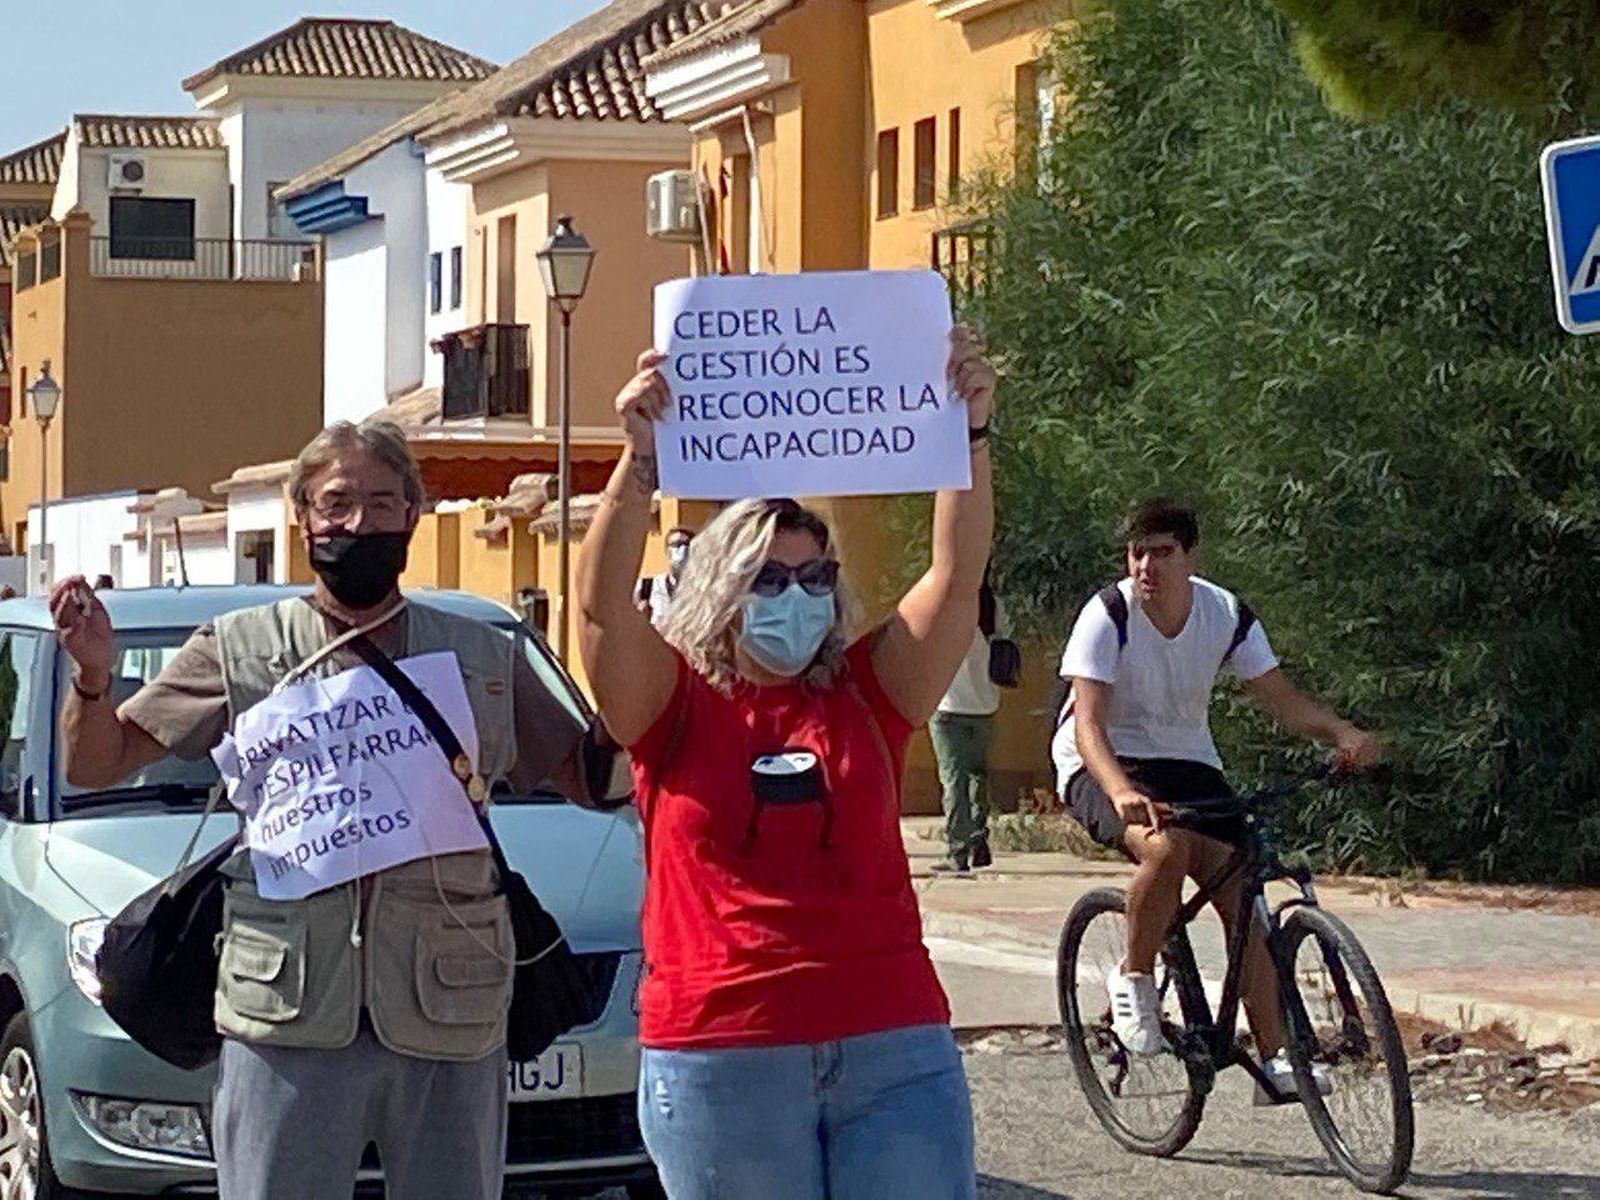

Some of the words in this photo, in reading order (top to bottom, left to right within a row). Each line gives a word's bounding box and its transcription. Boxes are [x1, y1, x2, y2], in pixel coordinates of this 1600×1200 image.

[674, 309, 782, 340] CEDER
[795, 306, 836, 335] LA
[676, 342, 820, 381] GESTIÓN
[835, 345, 870, 374] ES
[679, 386, 886, 422] RECONOCER
[898, 383, 939, 412] LA
[680, 426, 915, 462] INCAPACIDAD
[261, 782, 373, 845] nuestros
[267, 808, 411, 882] impuestos
